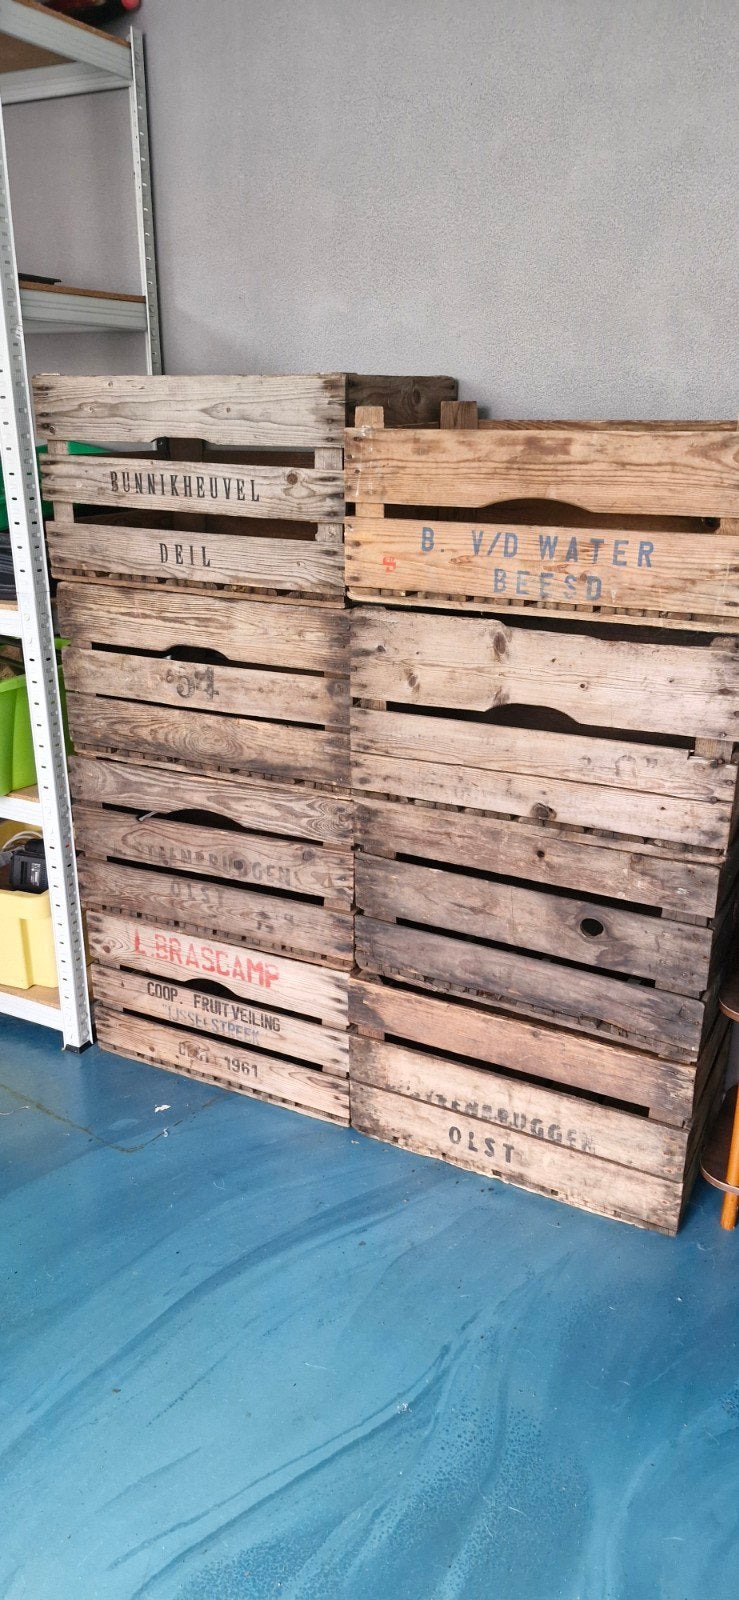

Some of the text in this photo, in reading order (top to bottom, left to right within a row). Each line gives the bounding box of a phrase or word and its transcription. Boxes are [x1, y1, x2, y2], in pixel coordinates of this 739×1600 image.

[110, 470, 260, 502] BUNNIKHEUVEL
[159, 542, 211, 567] DEIL
[420, 526, 655, 568] B. V/D WATER
[493, 568, 603, 601] BEESD
[147, 981, 281, 1033] COOP. FRUITVEILING
[224, 1055, 259, 1078] 1961
[448, 1125, 515, 1164] OLST
